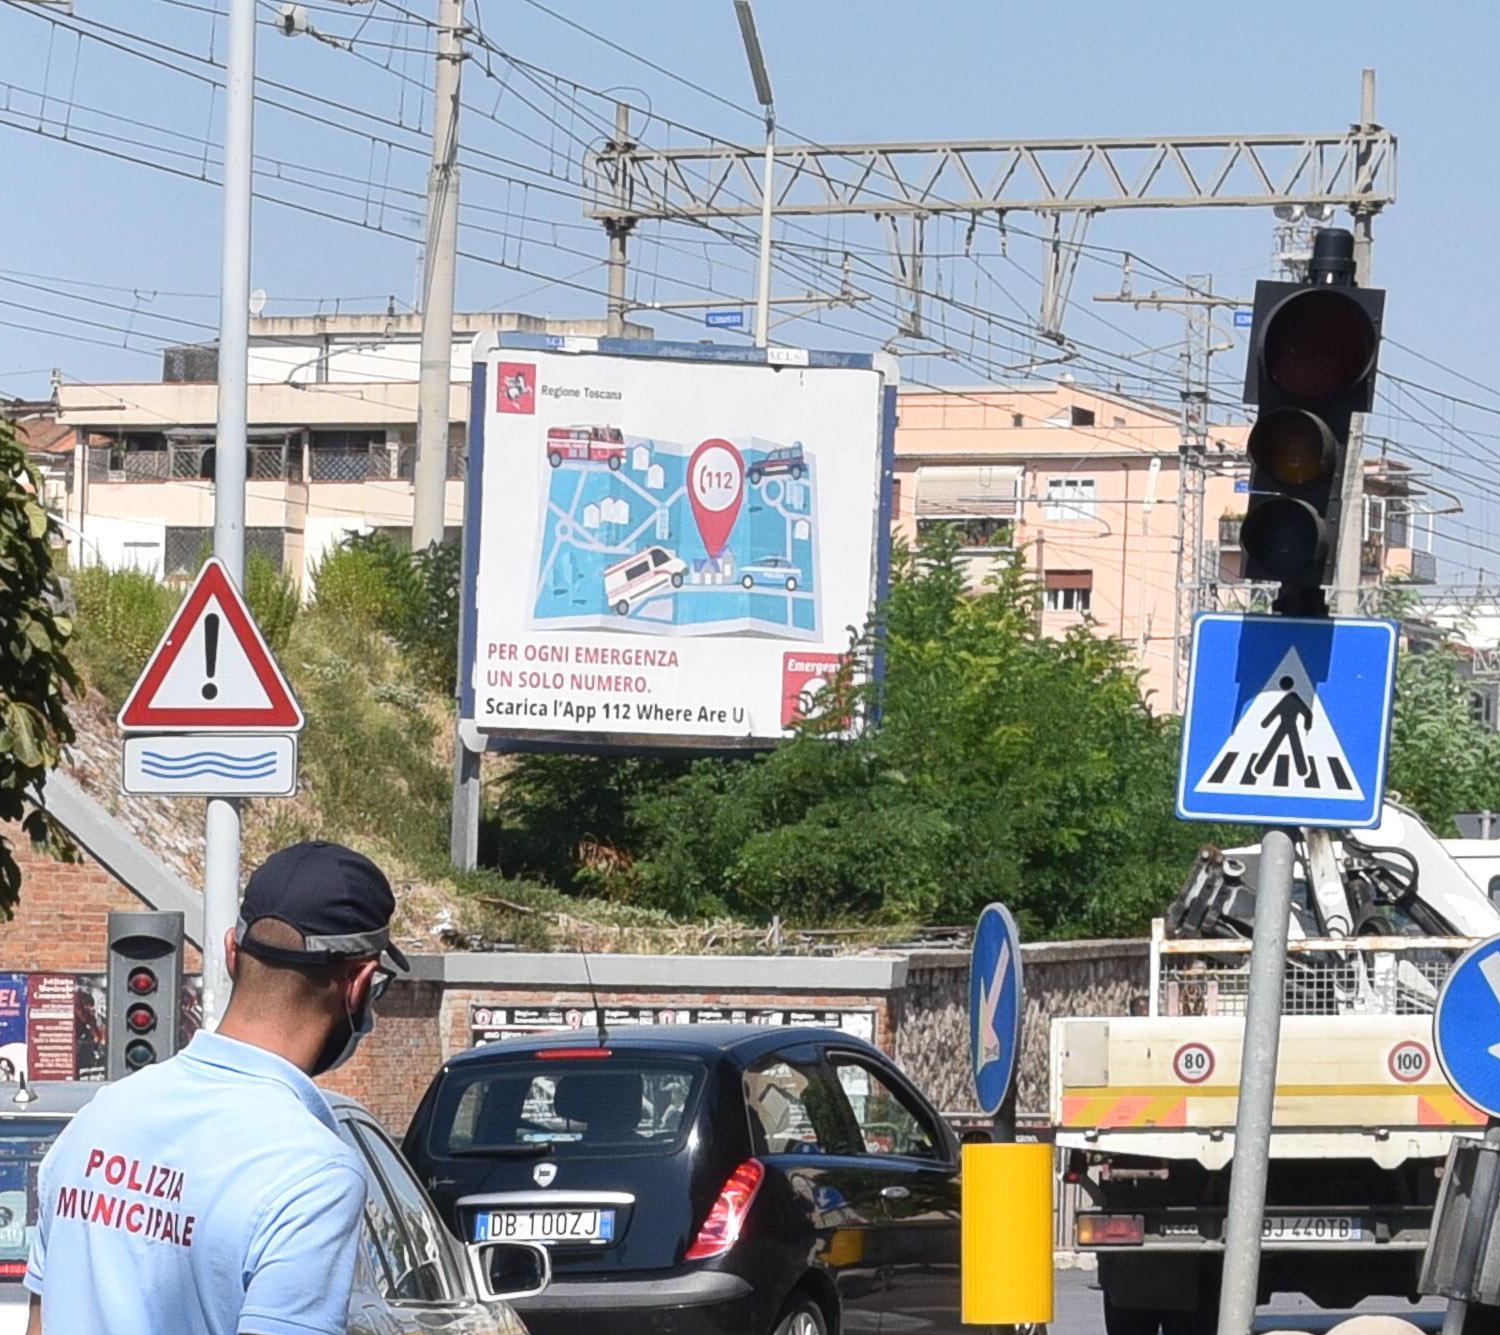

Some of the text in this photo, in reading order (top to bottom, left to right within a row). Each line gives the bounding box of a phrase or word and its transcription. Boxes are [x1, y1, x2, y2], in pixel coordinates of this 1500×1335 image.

[541, 384, 622, 401] Regione Toscana
[706, 471, 733, 490] 112
[488, 643, 679, 667] PER OGNI EMERGENZA
[487, 670, 652, 693] UN SOLO NUMERO.
[485, 697, 548, 717] Scarica
[602, 702, 631, 720] 112
[636, 703, 693, 722] Where
[697, 705, 727, 723] Are
[733, 707, 744, 723] U
[1184, 1053, 1205, 1069] 80
[1397, 1053, 1422, 1070] 100
[85, 1149, 184, 1202] POLIZIA
[56, 1186, 195, 1247] MUNICIPALE
[491, 1213, 517, 1237] DB
[529, 1211, 598, 1236] 100ZJ
[1291, 1219, 1349, 1238] 440TB
